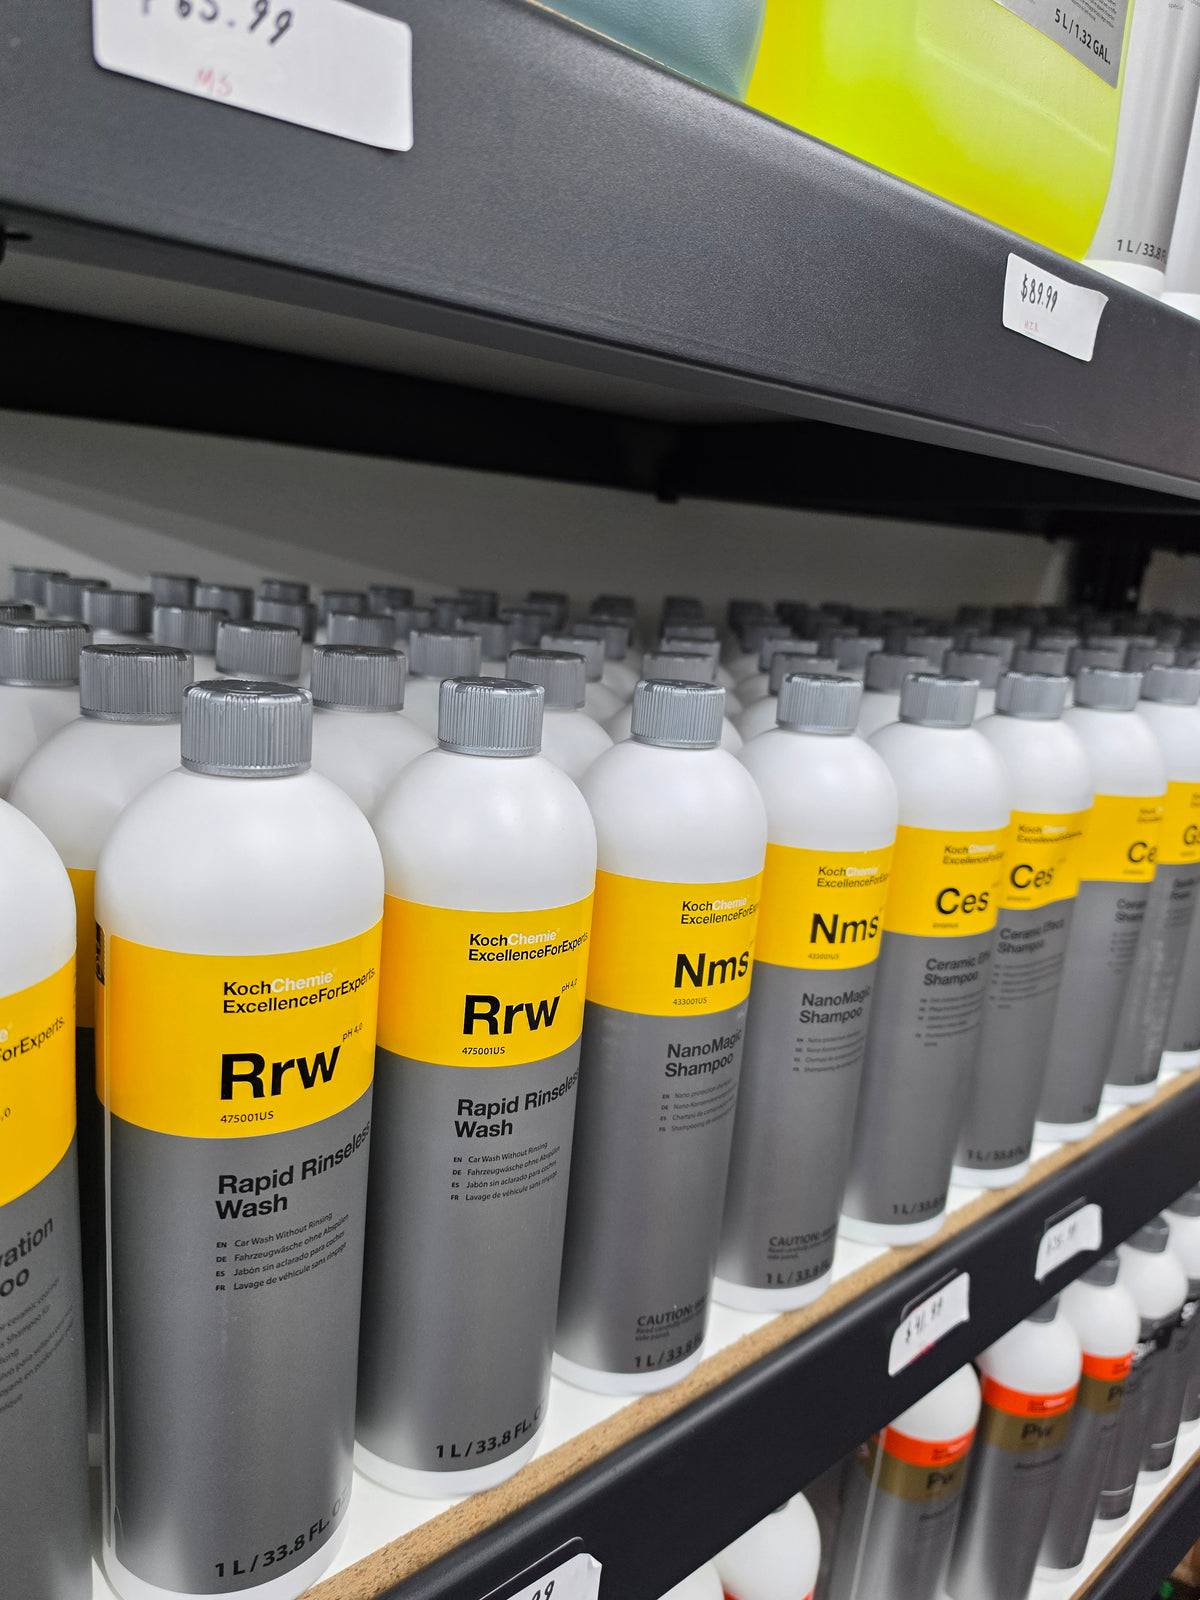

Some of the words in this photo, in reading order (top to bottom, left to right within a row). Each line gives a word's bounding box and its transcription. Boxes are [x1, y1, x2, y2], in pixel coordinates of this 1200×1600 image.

[1054, 8, 1061, 23] 5
[1062, 13, 1068, 30] L
[1075, 24, 1092, 50] 1.32
[1093, 39, 1111, 65] GAL.
[1117, 239, 1123, 252] 1
[1020, 273, 1058, 312] $89.99
[1009, 864, 1055, 888] Ces
[682, 898, 747, 911] KochChemie
[936, 887, 989, 915] Ces
[470, 930, 557, 946] KochChemie
[809, 913, 878, 943] Nms
[468, 931, 588, 962] ExcellenceForExperts
[674, 951, 749, 988] Nms
[223, 971, 333, 996] KochChemie
[223, 968, 376, 1014] ExcellenceForExperts
[463, 994, 560, 1035] Rrw
[673, 997, 708, 1006] 433001US
[799, 1007, 863, 1024] Shampoo
[0, 1016, 65, 1062] orExperts
[342, 1029, 353, 1043] pH
[462, 1046, 506, 1055] 475001US
[220, 1045, 341, 1100] Rrw
[664, 1053, 734, 1077] Shampoo
[220, 1110, 275, 1123] 475001US
[457, 1096, 519, 1119] Rapid
[454, 1119, 513, 1138] Wash
[481, 1154, 501, 1163] Wash
[501, 1149, 528, 1160] Without
[218, 1165, 294, 1196] Rapid
[466, 1179, 488, 1188] Jabón
[489, 1179, 500, 1187] sin
[215, 1194, 288, 1220] Wash
[465, 1194, 491, 1202] Lavage
[491, 1191, 501, 1199] de
[234, 1238, 250, 1248] Car
[250, 1233, 274, 1246] Wash
[276, 1224, 307, 1240] Without
[308, 1212, 333, 1230] Rinsing
[234, 1240, 303, 1262] Fahrzeugwäsche
[304, 1232, 322, 1246] ohne
[233, 1265, 260, 1277] Jabón
[262, 1263, 274, 1273] sin
[275, 1252, 309, 1269] aclarado
[310, 1244, 325, 1258] para
[233, 1279, 265, 1291] Lavage
[266, 1275, 277, 1285] de
[278, 1265, 310, 1282] véhicule
[634, 1355, 641, 1368] 1
[646, 1354, 655, 1367] L
[436, 1445, 444, 1458] 1
[450, 1444, 461, 1458] L
[476, 1430, 511, 1454] 33.8
[514, 1418, 532, 1439] FL.
[215, 1562, 224, 1578] 1
[233, 1560, 246, 1576] L
[262, 1534, 305, 1567] 33.8
[309, 1518, 330, 1542] FL.
